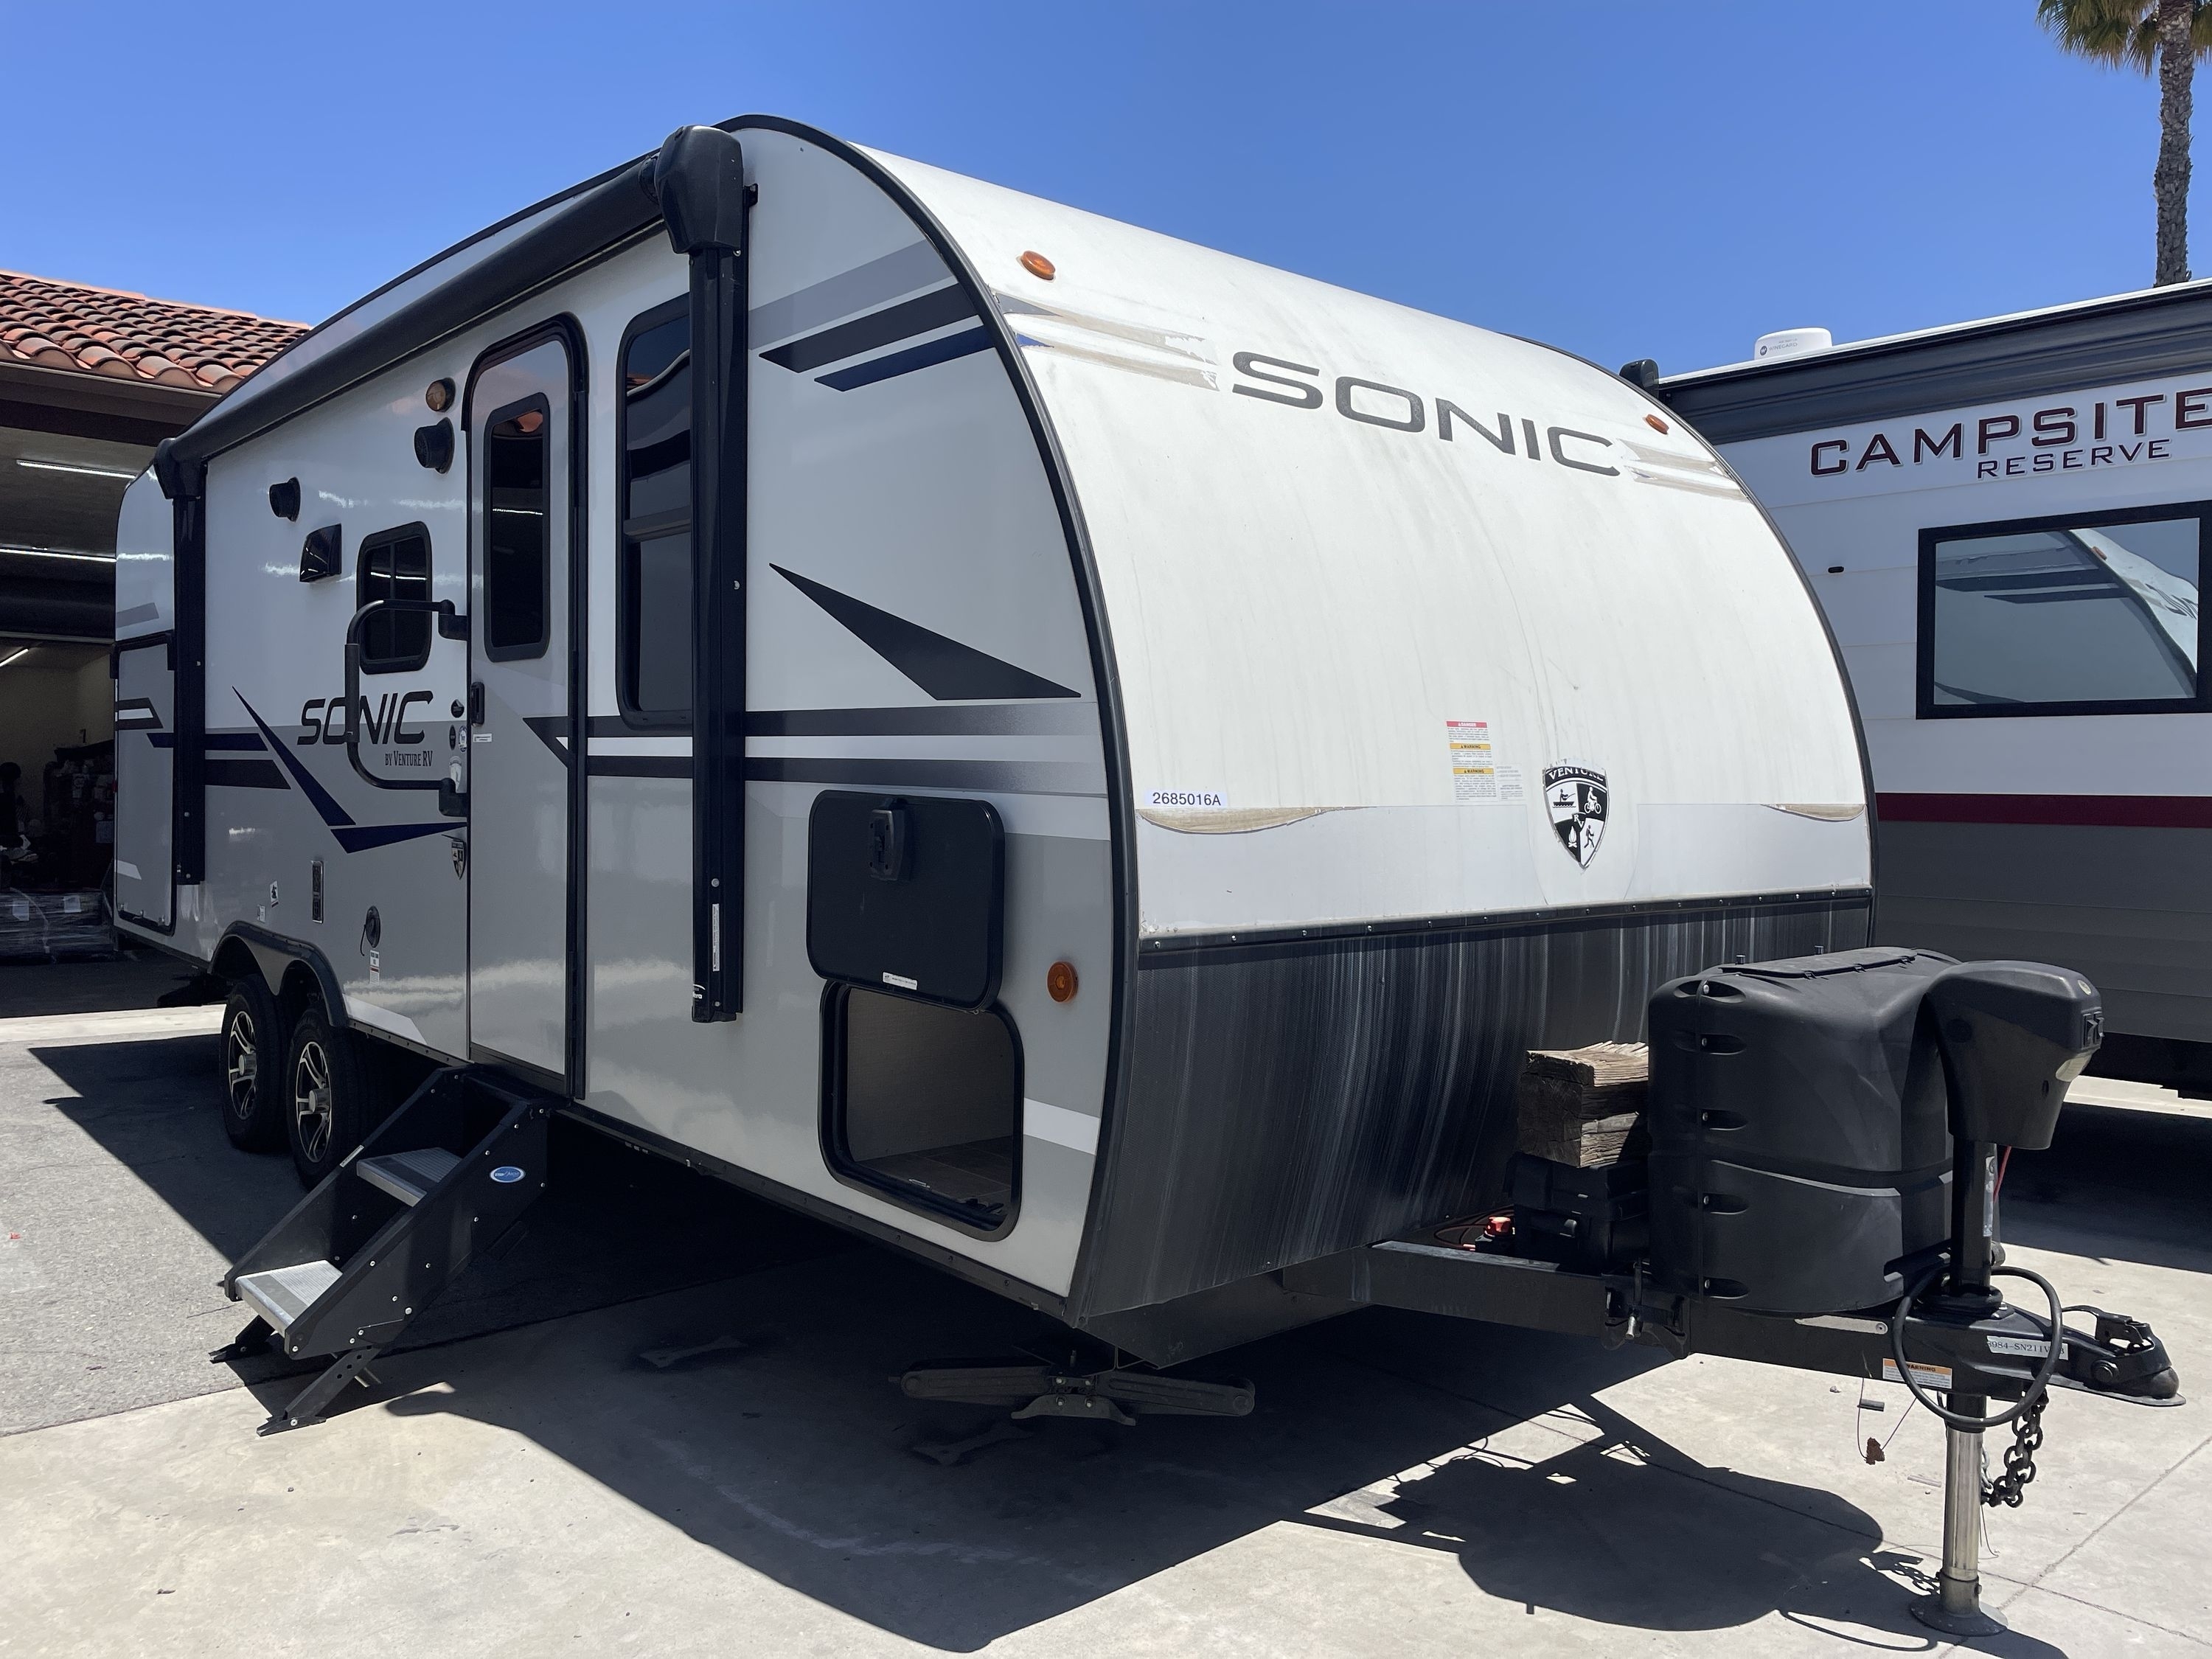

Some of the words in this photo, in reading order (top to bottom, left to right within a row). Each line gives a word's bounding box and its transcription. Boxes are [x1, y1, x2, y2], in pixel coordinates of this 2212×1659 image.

[1770, 342, 1798, 351] WINEGARD
[1232, 351, 1621, 476] SONIC
[1810, 387, 2212, 476] CAMPSITE
[1977, 439, 2171, 479] RESERVE
[297, 690, 434, 745] SONIC
[385, 754, 392, 766] BY
[422, 751, 433, 766] RV
[1152, 792, 1221, 806] 2685016A
